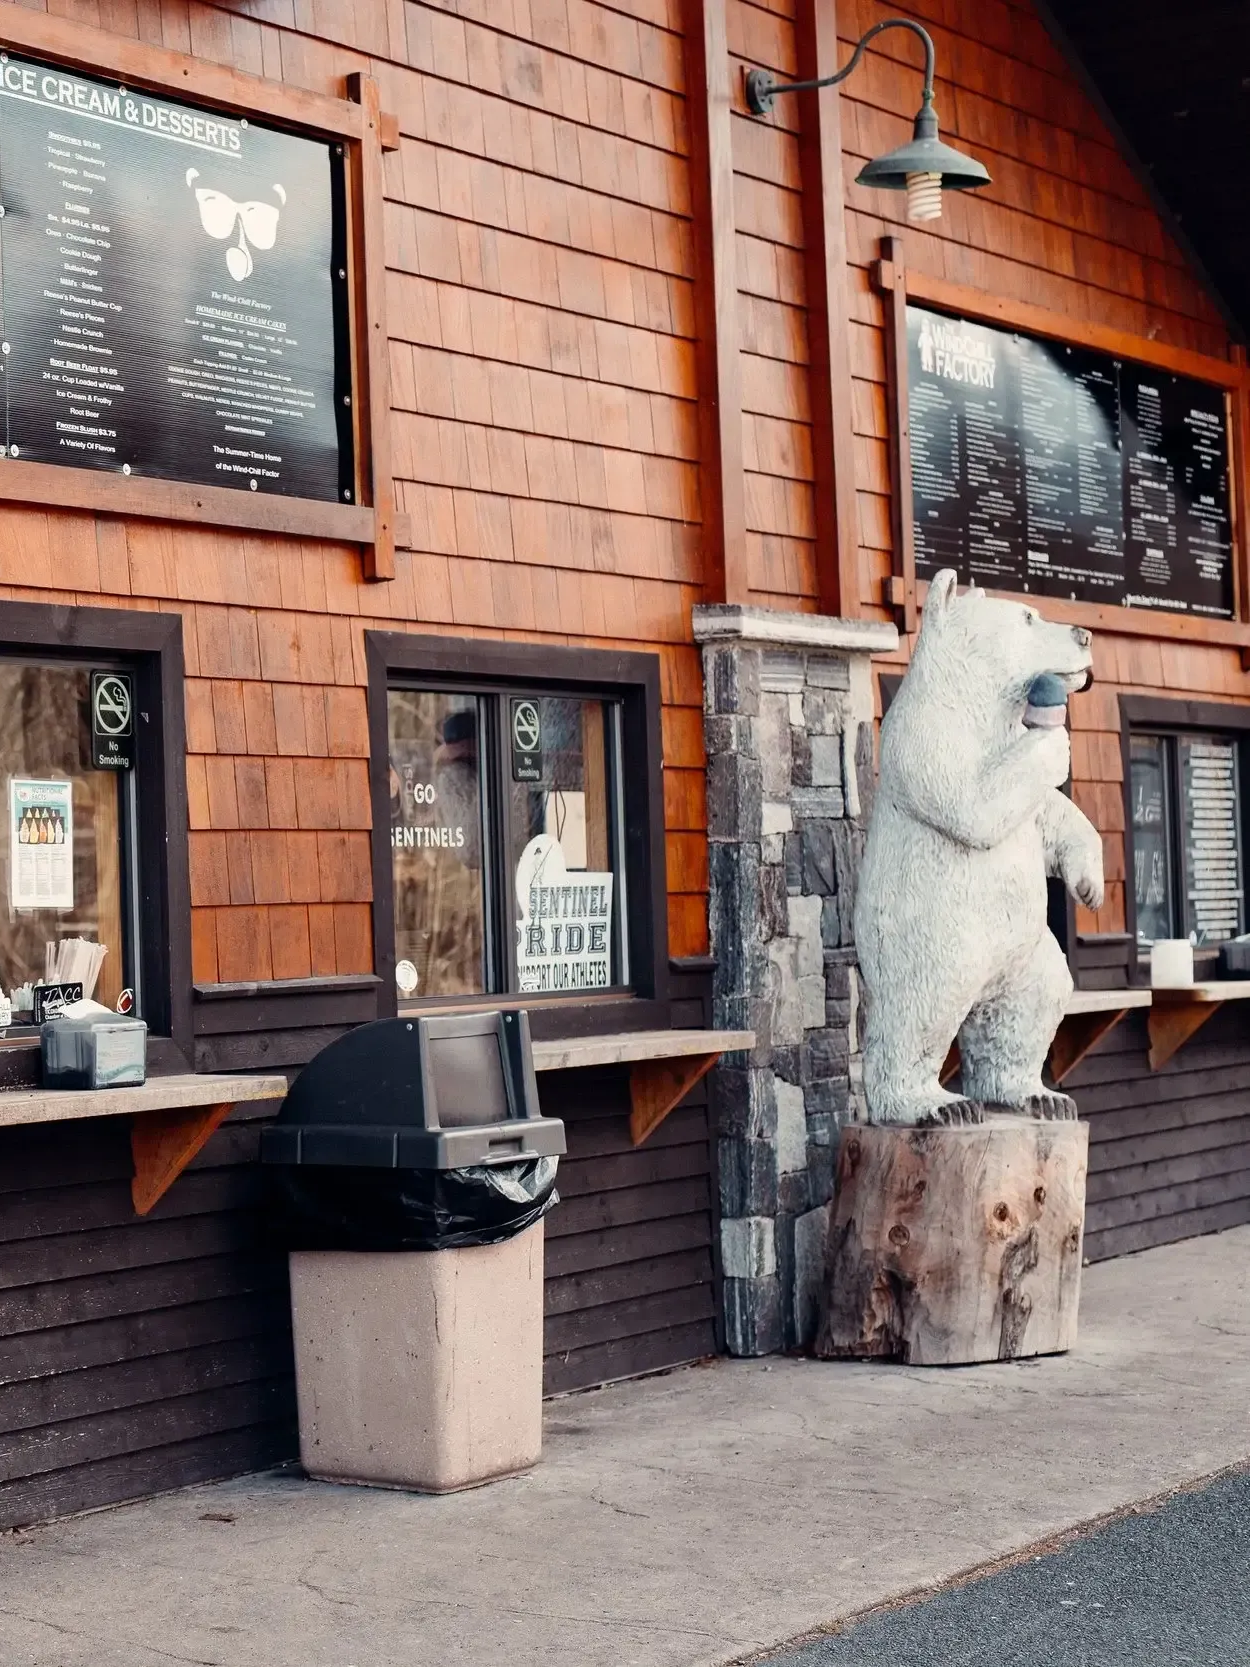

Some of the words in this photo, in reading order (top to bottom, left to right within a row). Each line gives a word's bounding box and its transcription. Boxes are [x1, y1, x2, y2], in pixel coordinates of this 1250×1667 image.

[0, 63, 37, 96] ICE
[42, 75, 121, 119] CREAM
[125, 100, 139, 123] &
[142, 107, 241, 150] DESSERTS
[935, 350, 996, 389] FACTORY
[265, 454, 281, 462] Home
[109, 741, 119, 751] No
[99, 755, 129, 768] Smoking
[524, 756, 532, 765] No
[518, 767, 540, 780] Smoking
[414, 783, 436, 804] GO
[529, 885, 607, 919] SENTINEL
[553, 963, 569, 989] OUR
[571, 960, 607, 987] ATHLETES
